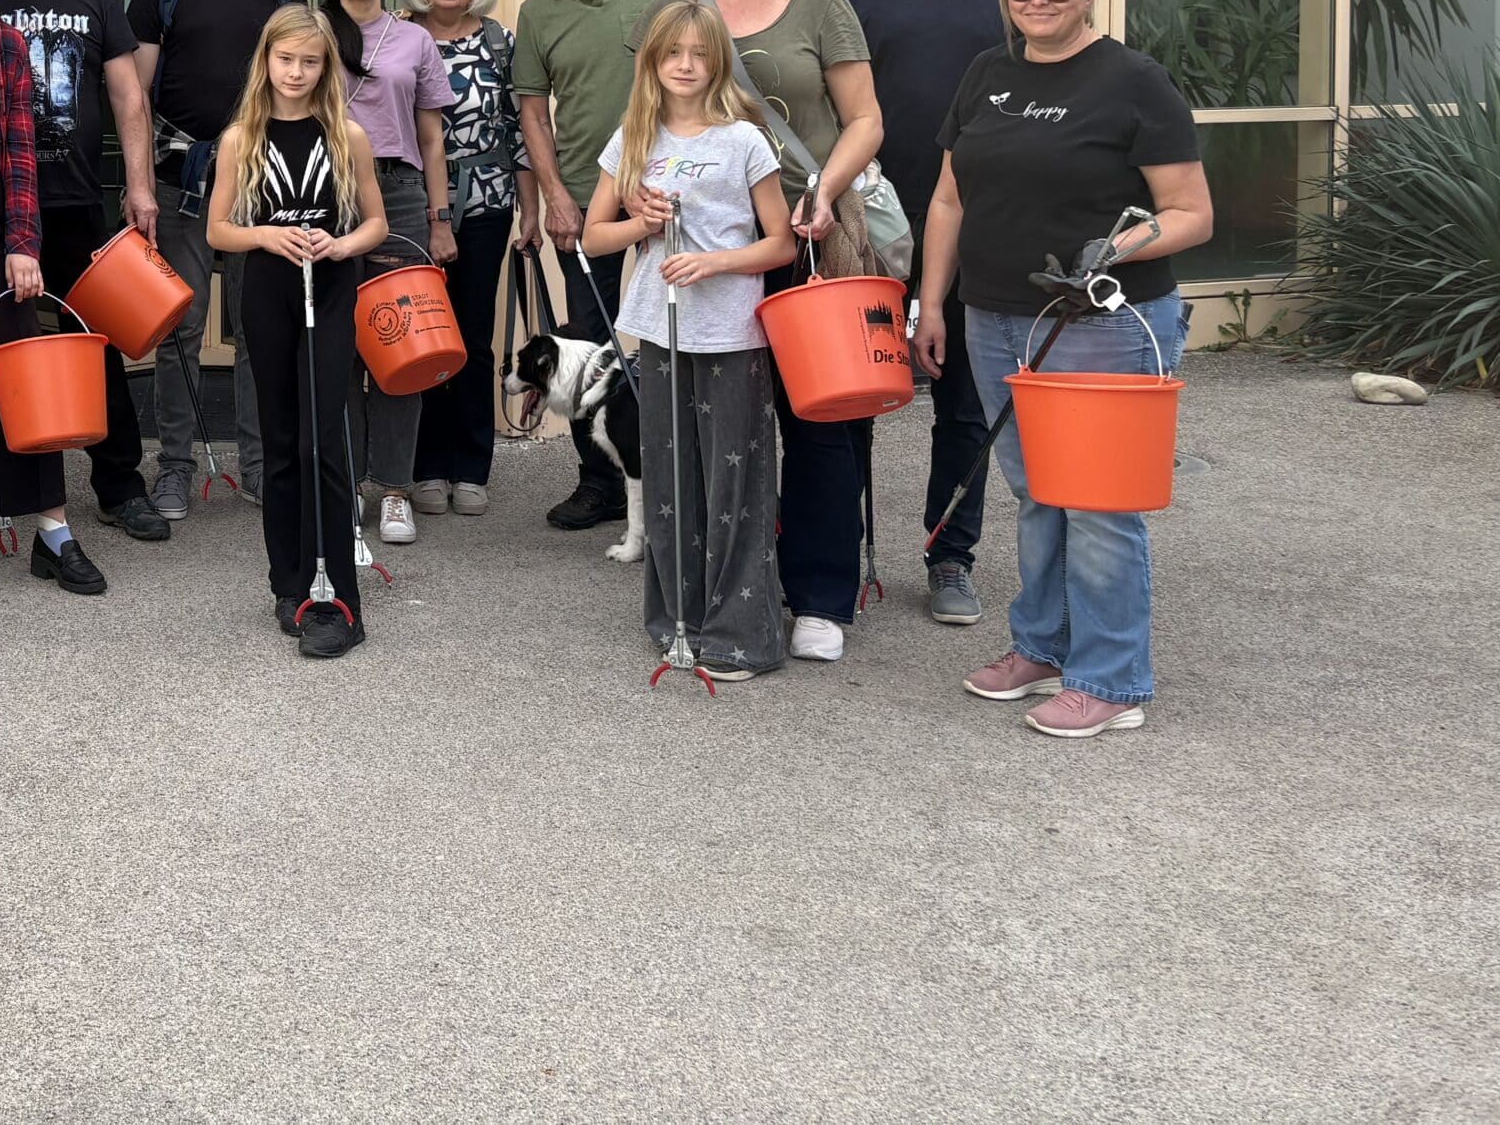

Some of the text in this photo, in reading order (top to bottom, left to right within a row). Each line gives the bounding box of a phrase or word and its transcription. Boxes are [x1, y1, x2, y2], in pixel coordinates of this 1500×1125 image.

[0, 6, 90, 34] abaton
[268, 209, 329, 222] MALICE
[873, 349, 894, 363] Die
